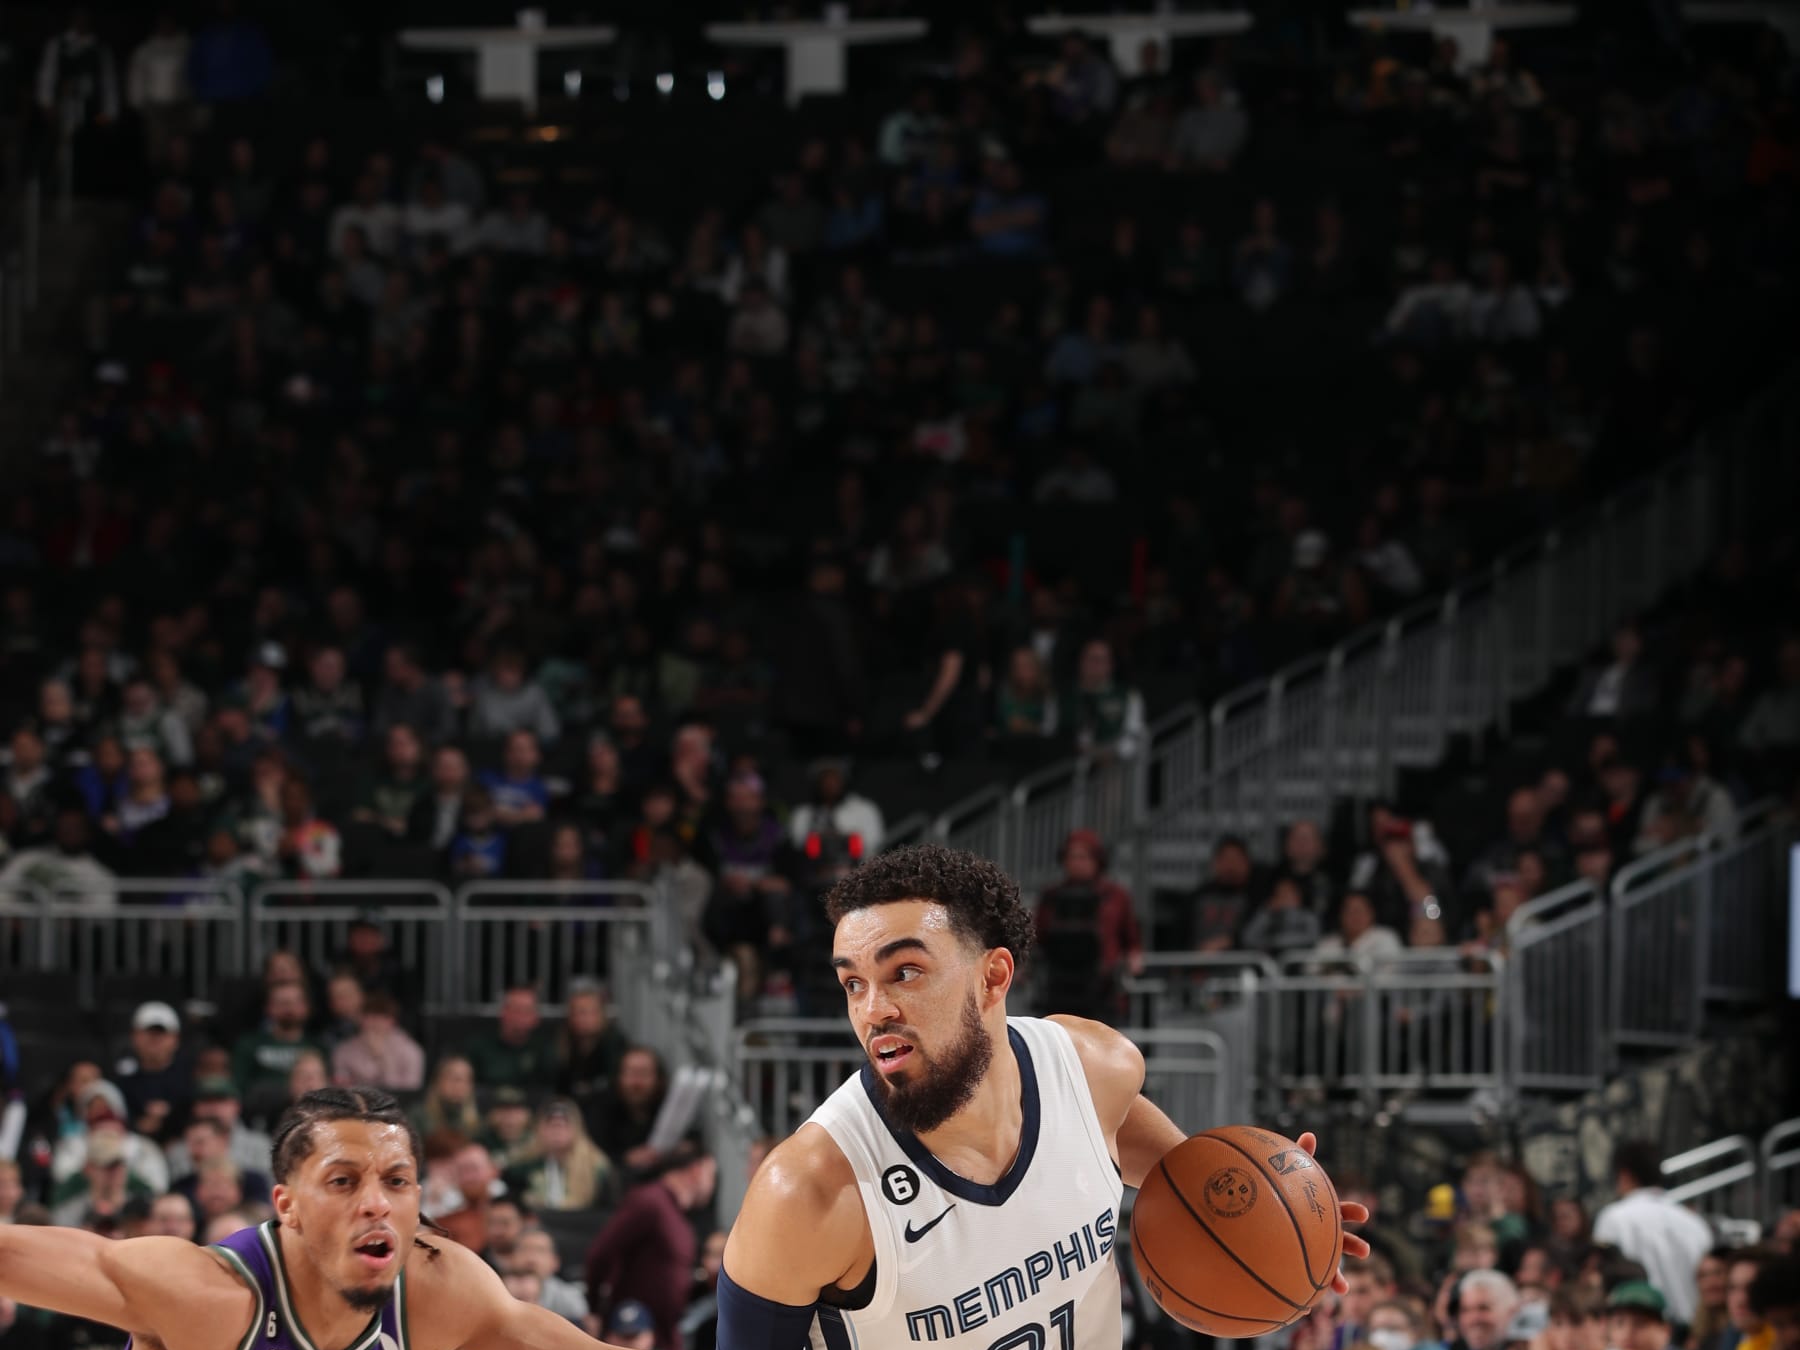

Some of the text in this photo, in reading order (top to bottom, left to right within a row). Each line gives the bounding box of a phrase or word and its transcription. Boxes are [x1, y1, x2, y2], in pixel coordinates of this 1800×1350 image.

[888, 1170, 913, 1201] 6
[905, 1208, 1116, 1341] MEMPHIS
[266, 1311, 277, 1338] 6
